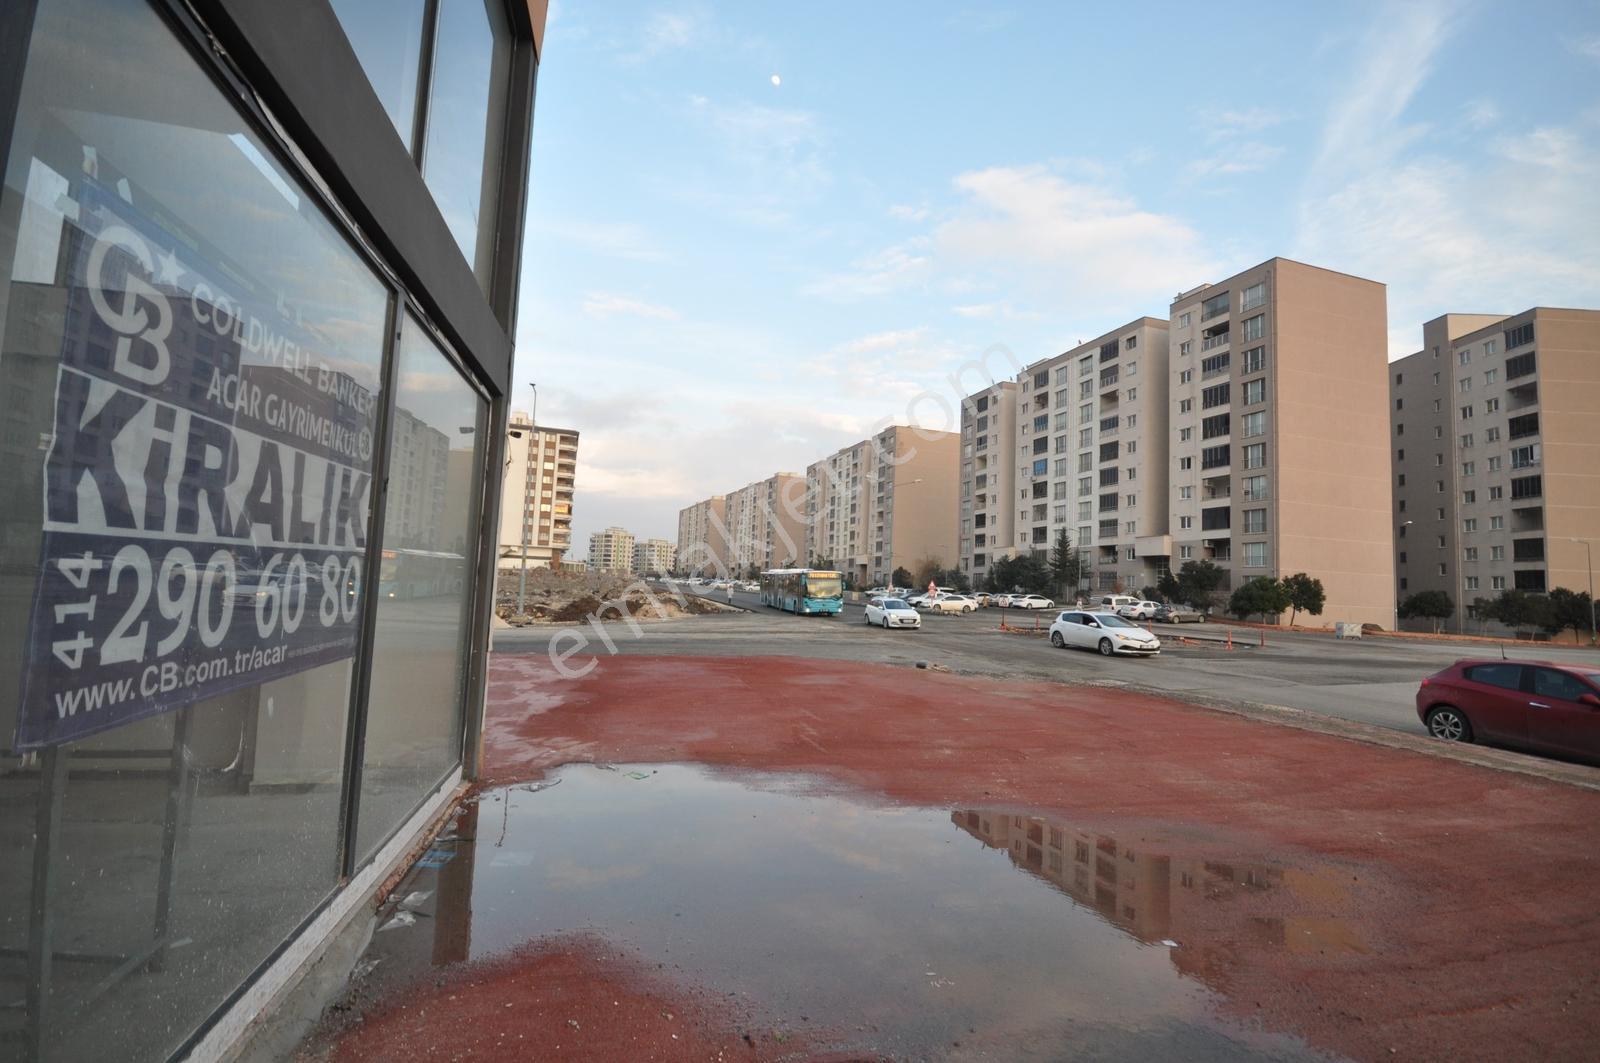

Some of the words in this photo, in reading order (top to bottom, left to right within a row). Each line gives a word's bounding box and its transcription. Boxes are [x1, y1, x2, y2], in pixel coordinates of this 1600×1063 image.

[191, 283, 313, 386] COLDWELL
[318, 361, 375, 419] BANKER
[206, 367, 261, 419] ACAR
[99, 544, 236, 666] 290
[255, 552, 307, 639] 60
[319, 554, 361, 628] 80
